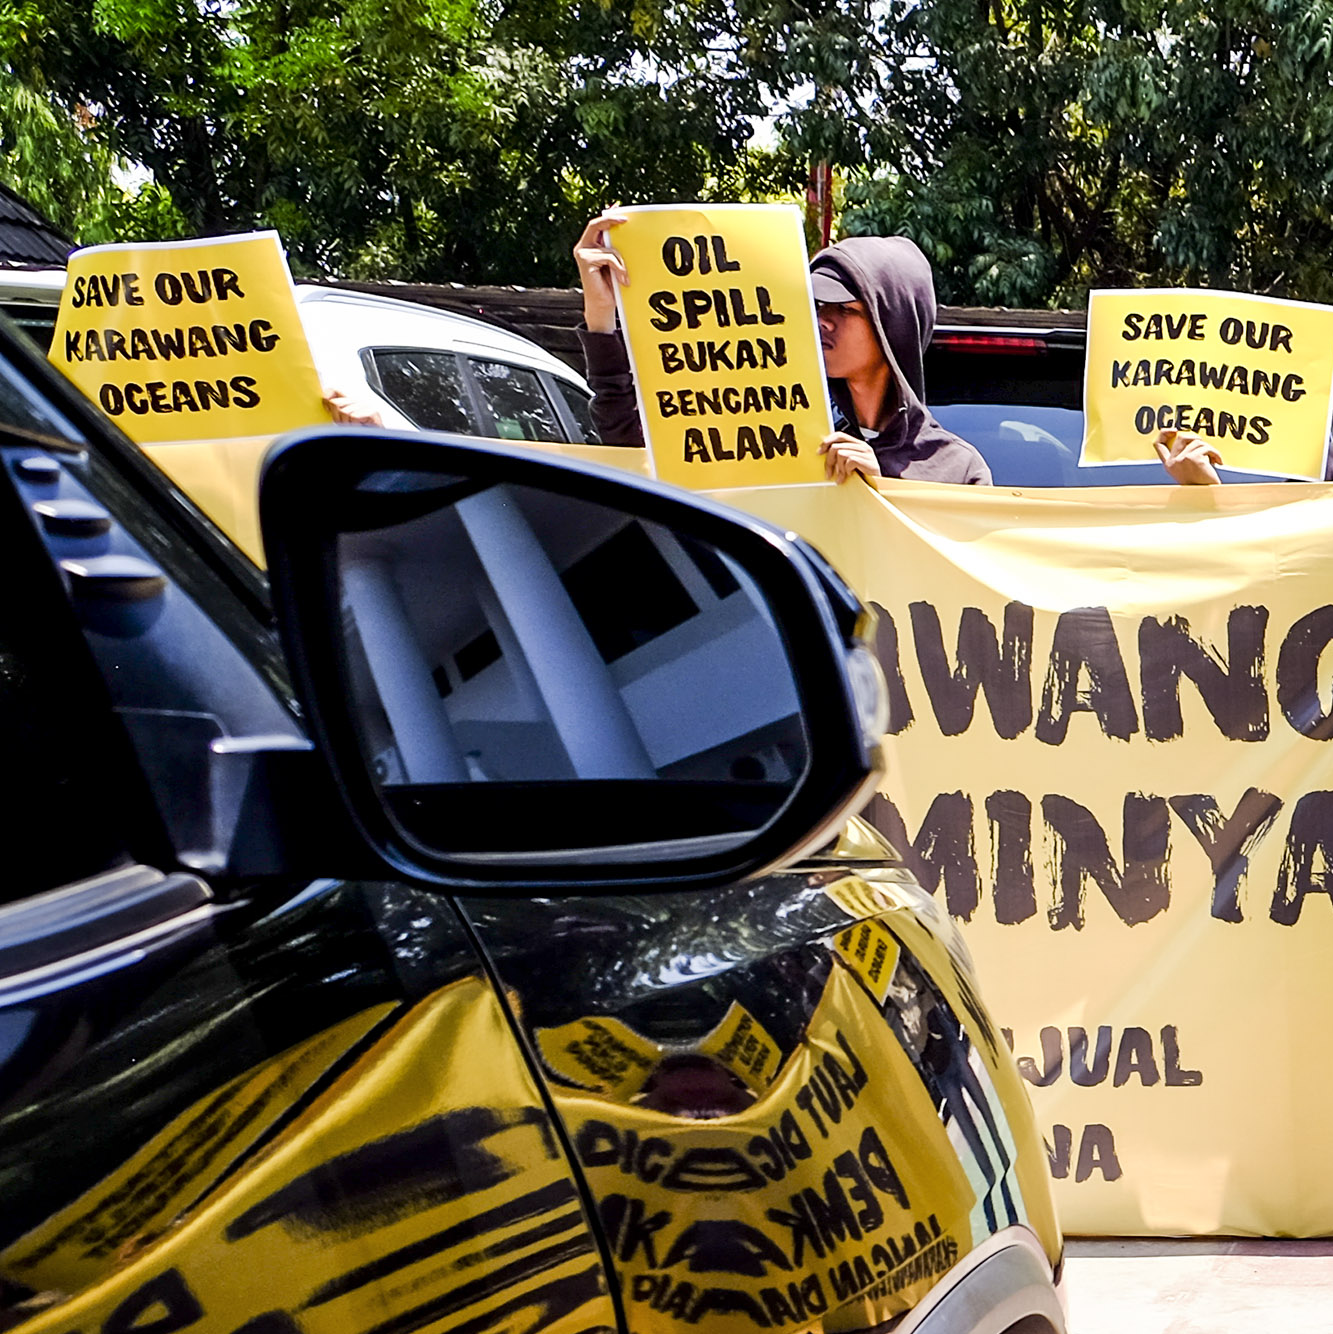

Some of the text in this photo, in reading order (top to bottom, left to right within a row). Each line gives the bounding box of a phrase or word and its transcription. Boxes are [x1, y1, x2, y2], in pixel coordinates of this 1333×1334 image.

[661, 235, 741, 277] OIL
[72, 268, 245, 308] SAVE OUR
[648, 286, 785, 332] SPILL
[65, 319, 281, 362] KARAWANG
[1121, 313, 1293, 354] SAVE OUR
[658, 336, 788, 375] BUKAN
[98, 375, 261, 416] OCEANS
[655, 383, 810, 418] BENCANA
[1111, 358, 1307, 402] KARAWANG
[684, 423, 799, 463] ALAM
[1134, 404, 1272, 446] OCEANS
[1000, 1024, 1203, 1088] JUAL
[1042, 1123, 1123, 1183] NA
